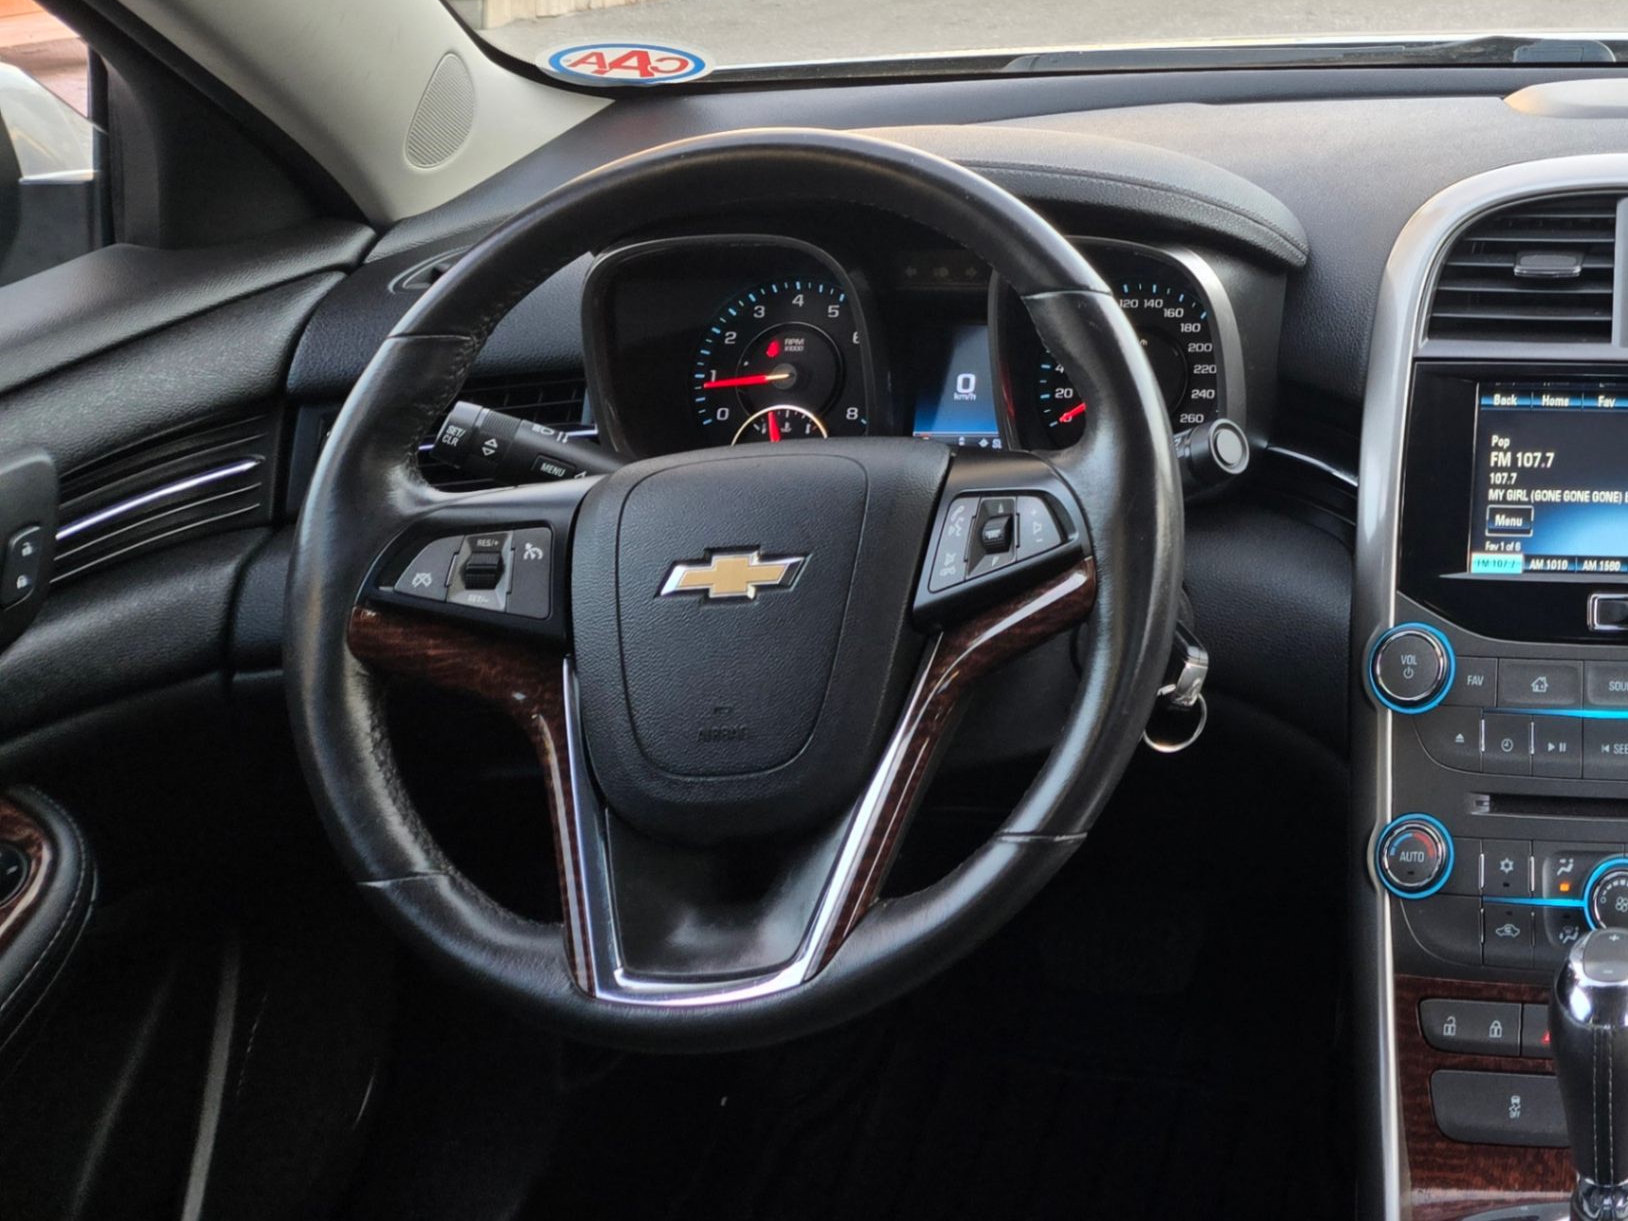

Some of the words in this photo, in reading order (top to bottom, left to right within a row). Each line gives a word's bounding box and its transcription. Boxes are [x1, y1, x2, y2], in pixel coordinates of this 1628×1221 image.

[792, 294, 804, 307] 4
[1143, 299, 1163, 308] 140
[753, 305, 765, 318] 3
[827, 305, 840, 318] 5
[1163, 308, 1184, 318] 160
[1180, 323, 1201, 333] 180
[725, 331, 737, 344] 2
[1188, 343, 1213, 353] 200
[1193, 364, 1217, 374] 220
[956, 373, 976, 393] 0
[1055, 388, 1073, 398] 20
[1191, 389, 1215, 399] 240
[1493, 394, 1517, 406] Back
[1541, 394, 1570, 407] Home
[1597, 395, 1616, 407] Fav
[717, 407, 729, 421] 0
[846, 407, 858, 420] 8
[1180, 413, 1204, 424] 260
[1491, 435, 1510, 449] Pop
[1490, 451, 1512, 467] FM
[1516, 451, 1555, 468] 107.7
[541, 462, 567, 478] MENU
[1489, 472, 1518, 485] 107.7
[1488, 489, 1504, 501] MY
[1506, 489, 1529, 502] GIRL
[1530, 489, 1562, 504] (GONE
[1563, 490, 1590, 502] GONE
[1591, 490, 1623, 504] GONE)
[1494, 514, 1523, 527] Menu
[1485, 541, 1498, 552] Fav
[1529, 559, 1544, 570] AM
[1546, 559, 1569, 571] 1010
[1582, 560, 1597, 571] AM
[1400, 655, 1418, 666] VOL
[1467, 675, 1484, 686] FAV
[1399, 851, 1425, 863] AUTO
